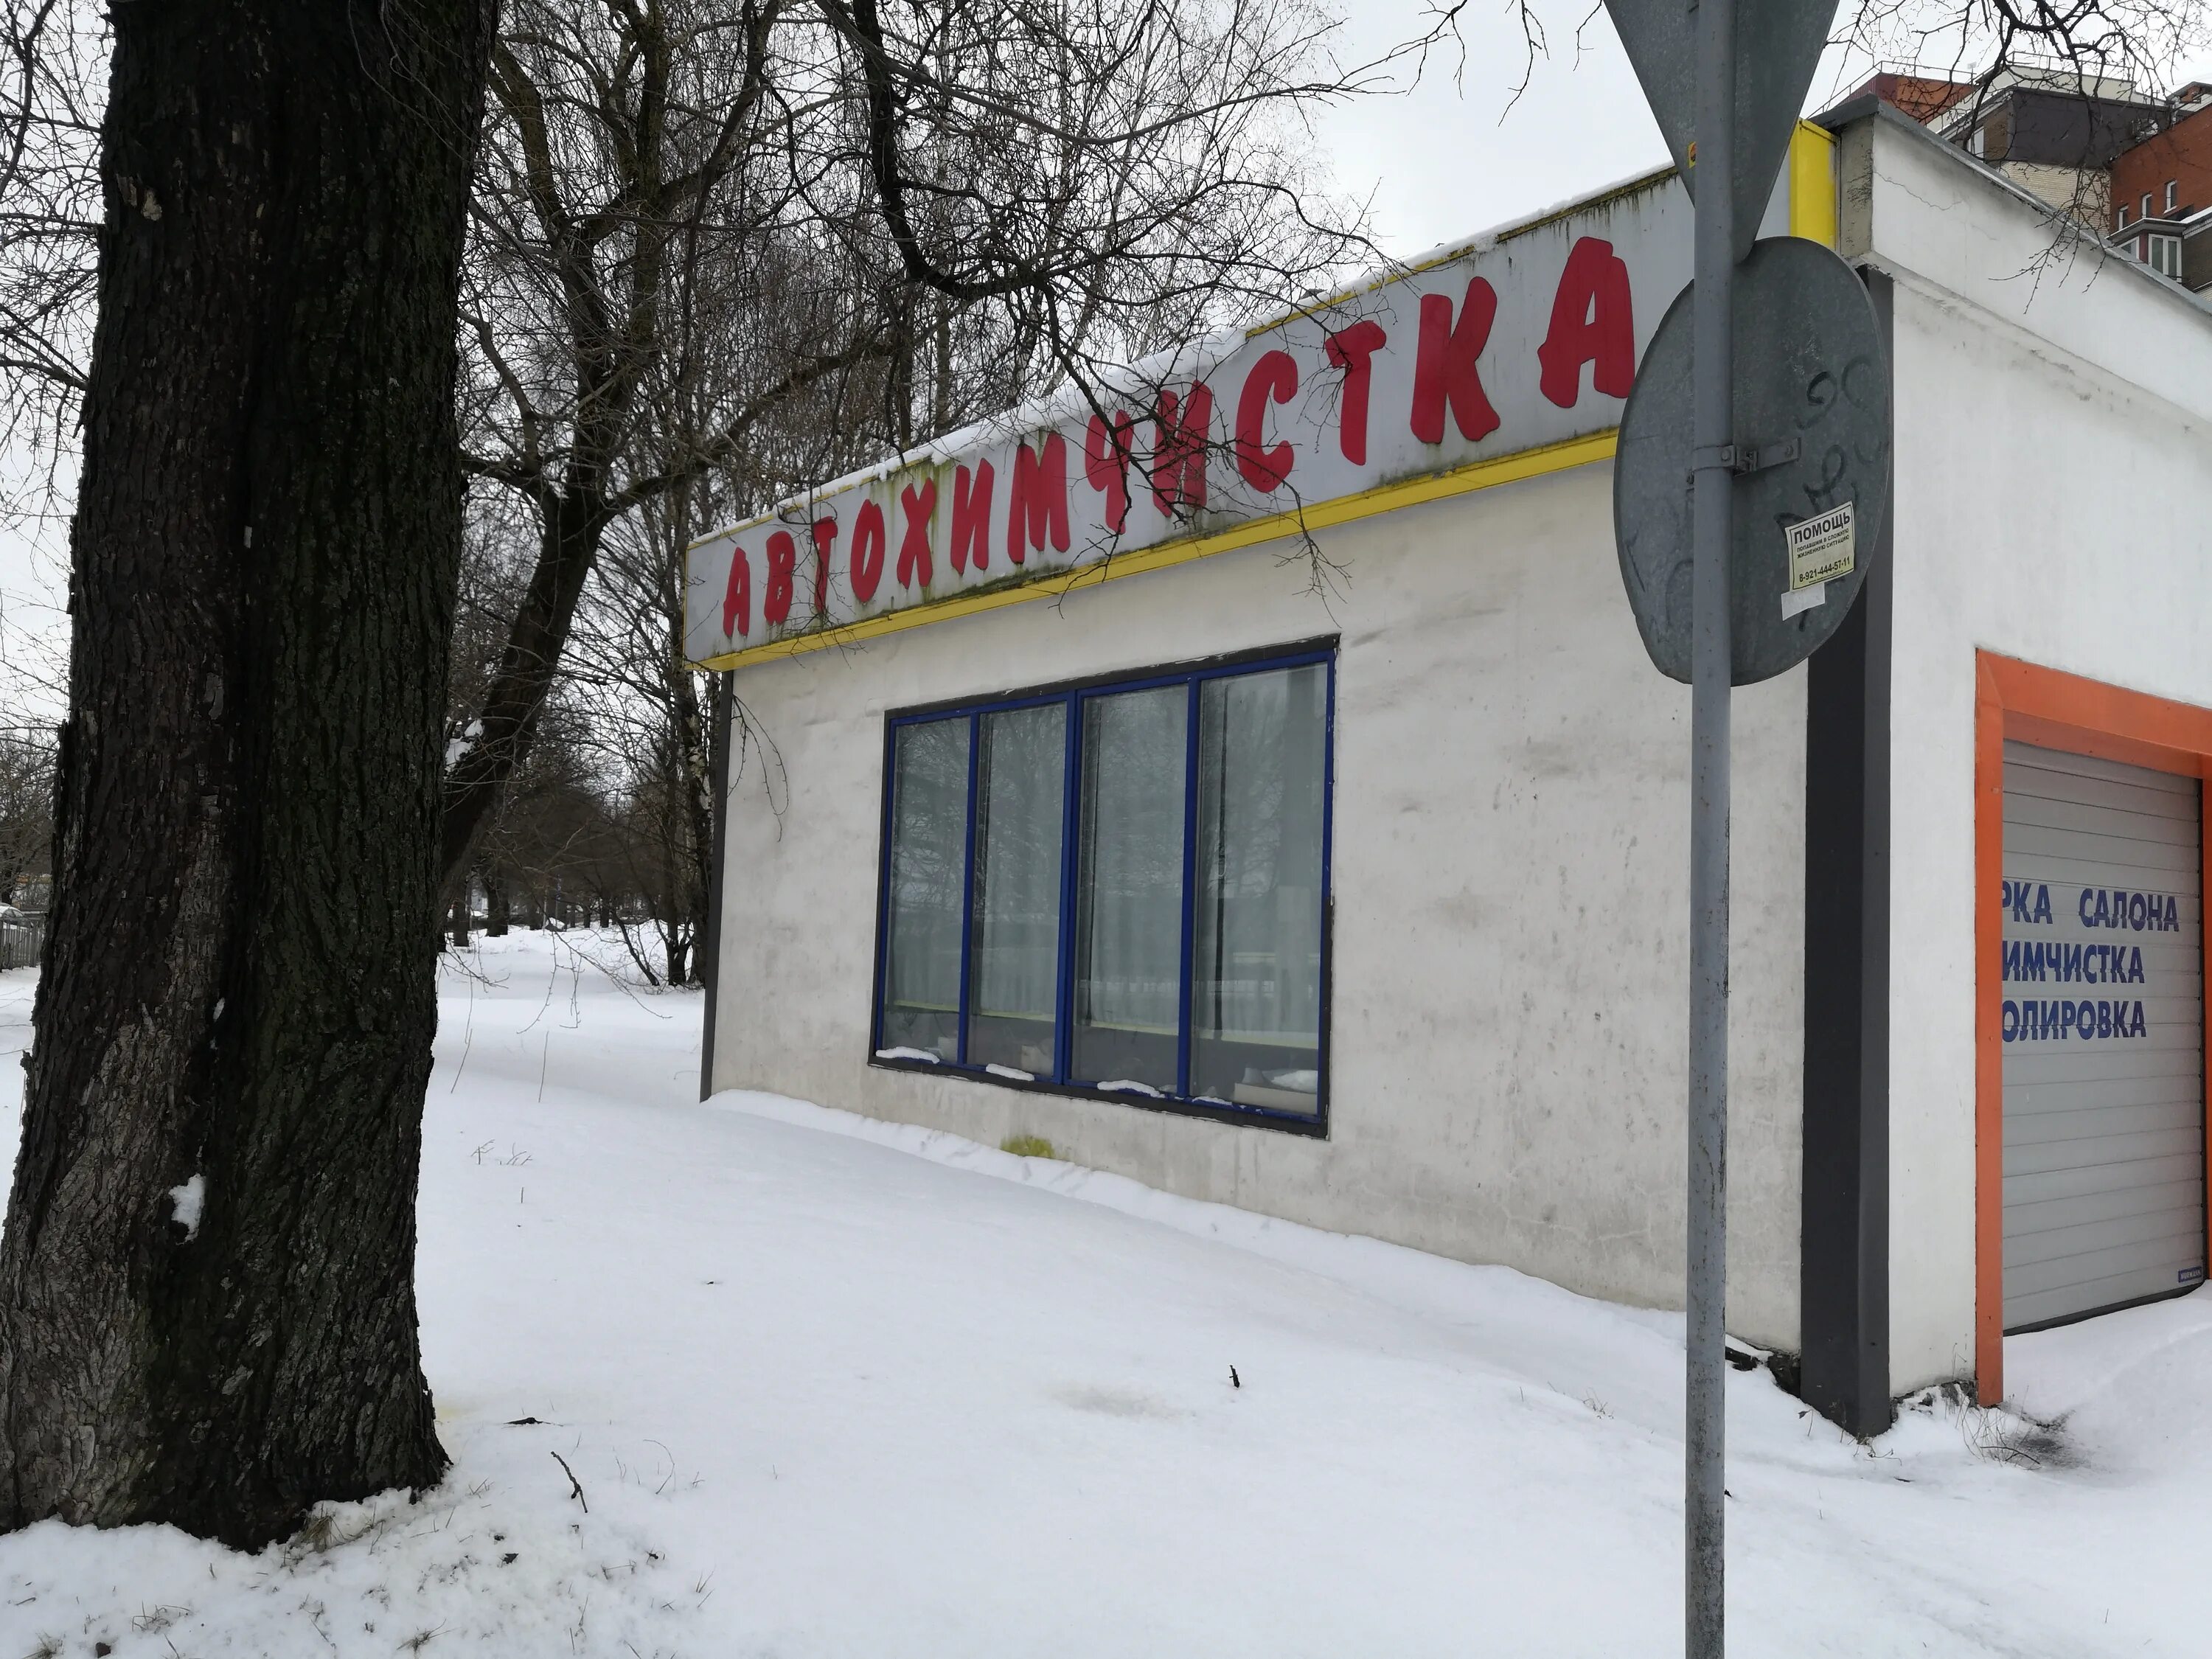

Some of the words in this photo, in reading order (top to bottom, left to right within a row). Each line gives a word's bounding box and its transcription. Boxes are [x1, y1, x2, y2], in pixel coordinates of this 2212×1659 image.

[723, 236, 1635, 639] АВТОХИМЧИСТКА
[1794, 512, 1850, 544] ПОМОЩЬ
[1797, 538, 1823, 553] ПОПАВШИМ
[1827, 528, 1849, 540] СЛОЖНУЮ
[1797, 544, 1826, 559] ЖИЗНЕННУЮ
[1826, 535, 1849, 548] СИТУАЦИЮ
[1799, 556, 1850, 582] 8-921-444-57-11
[2079, 888, 2180, 932] САЛОНА
[2002, 1000, 2146, 1043] ОЛИРОВКА
